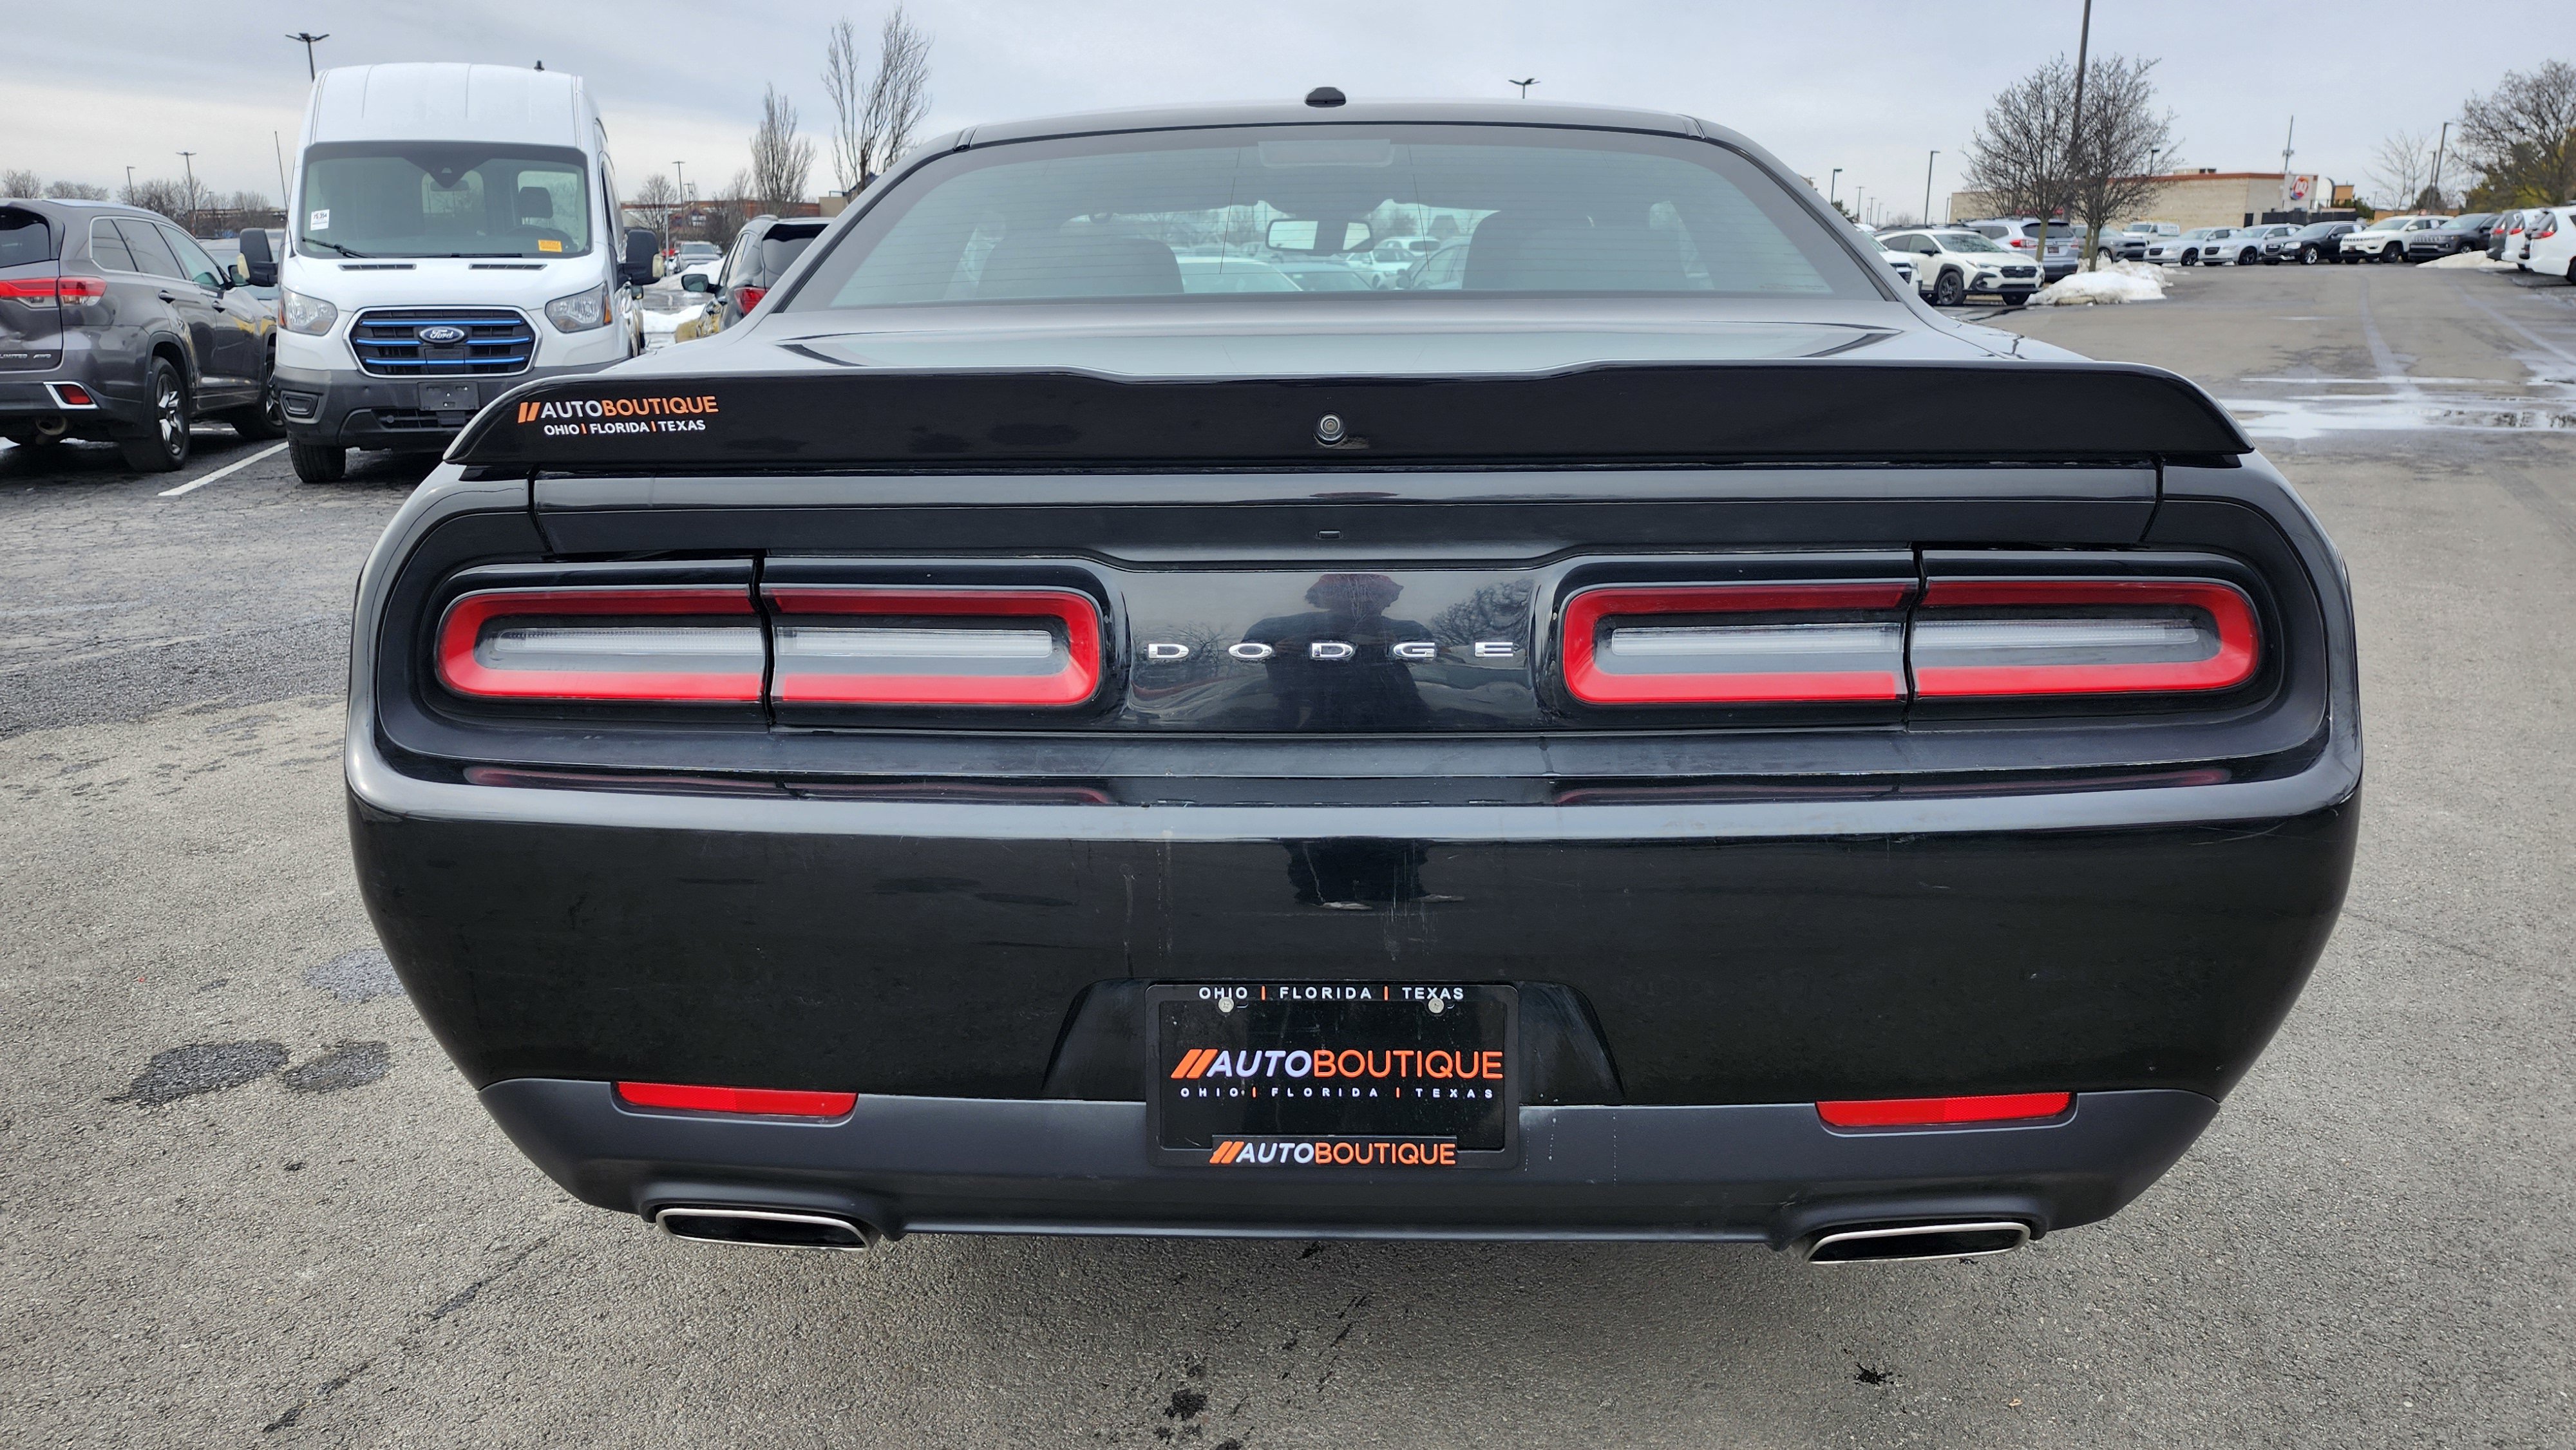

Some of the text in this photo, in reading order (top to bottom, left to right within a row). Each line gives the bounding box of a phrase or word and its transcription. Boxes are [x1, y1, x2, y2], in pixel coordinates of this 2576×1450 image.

[430, 329, 453, 339] Ford
[541, 396, 719, 419] AUTOBOUTIQUE
[544, 419, 706, 436] OHIO FLORIDA TEXAS
[1148, 642, 1514, 659] DODGE
[1198, 986, 1464, 999] OHIO FLORIDA TEXAS
[1206, 1050, 1504, 1079] AUTOBOUTIQUE
[1180, 1088, 1493, 1098] OHIO FLORIDA TEXAS
[1235, 1142, 1456, 1164] AUTOBOUTIQUE
